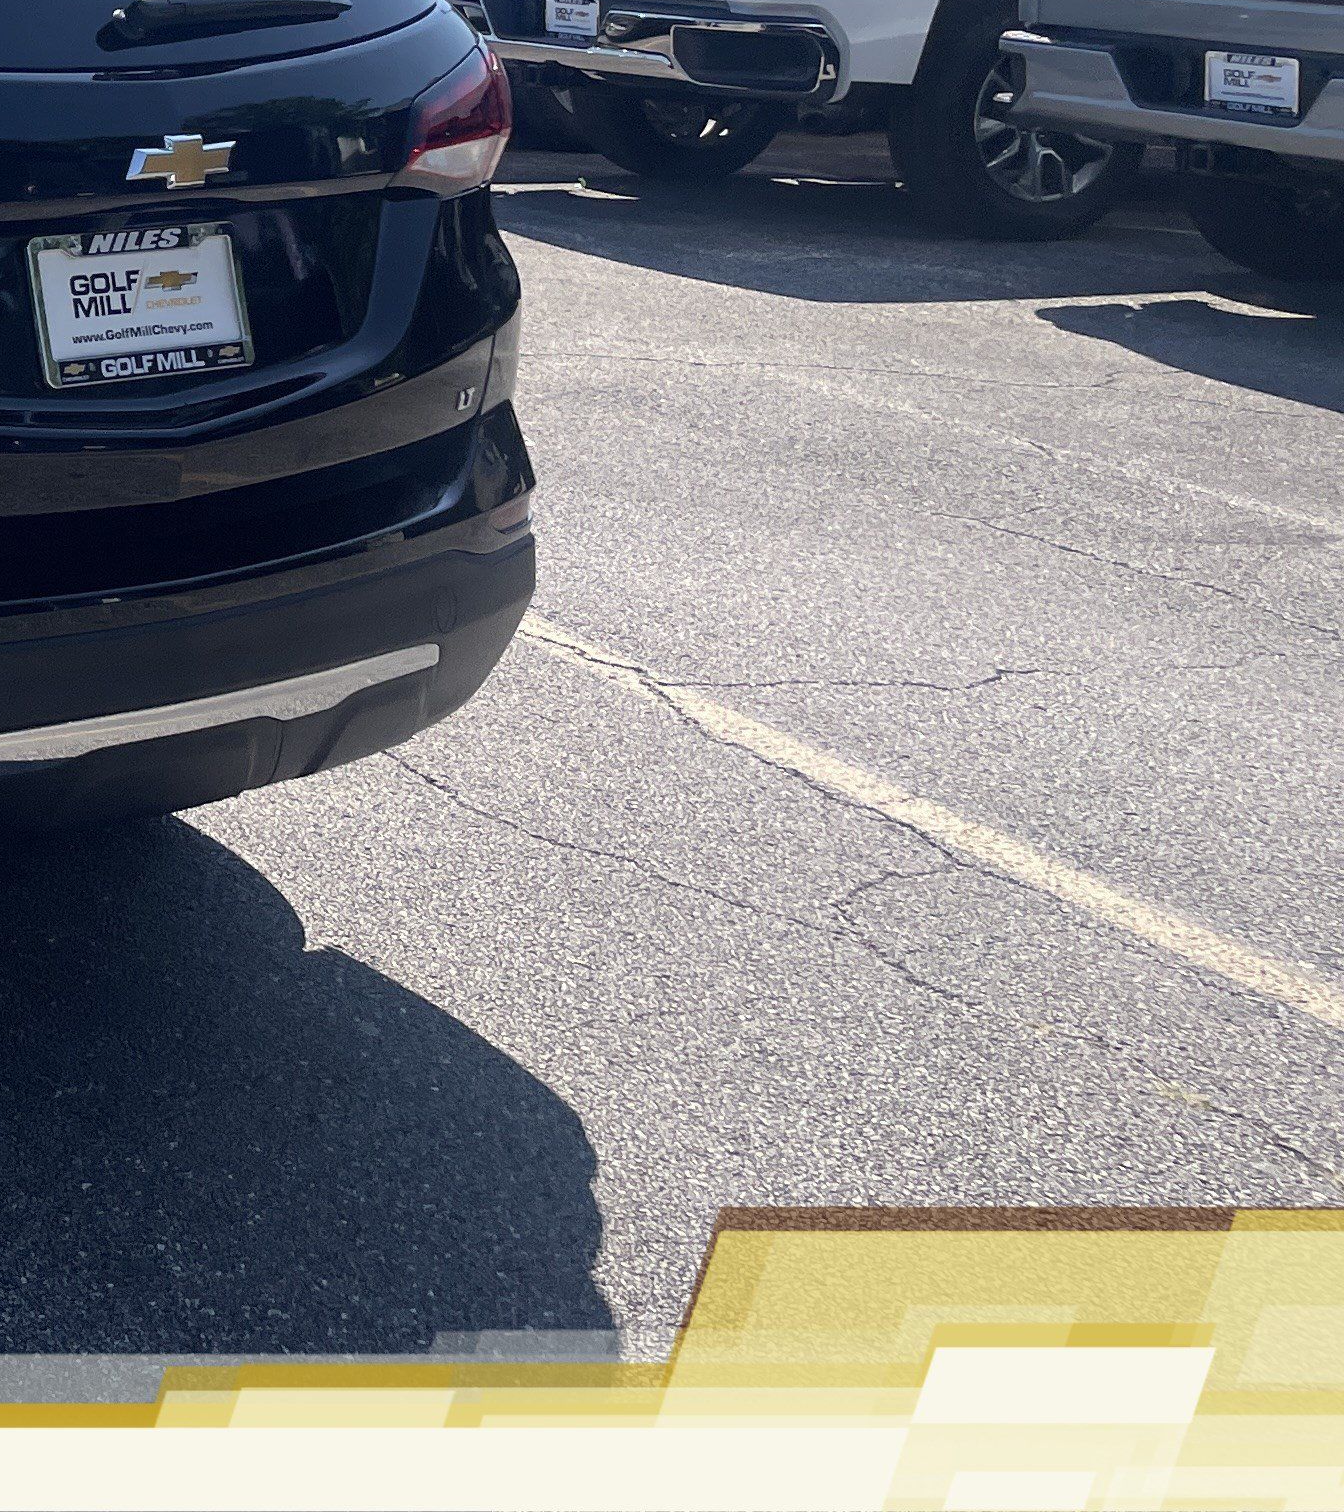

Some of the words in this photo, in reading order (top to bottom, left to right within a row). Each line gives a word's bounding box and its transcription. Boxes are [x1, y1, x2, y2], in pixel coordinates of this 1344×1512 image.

[88, 227, 182, 254] NILES
[69, 269, 141, 296] GOLF
[72, 293, 132, 319] MILL
[71, 321, 214, 345] www.GolfMillChevy.com
[100, 354, 155, 378] GOLF
[157, 349, 205, 372] MILL
